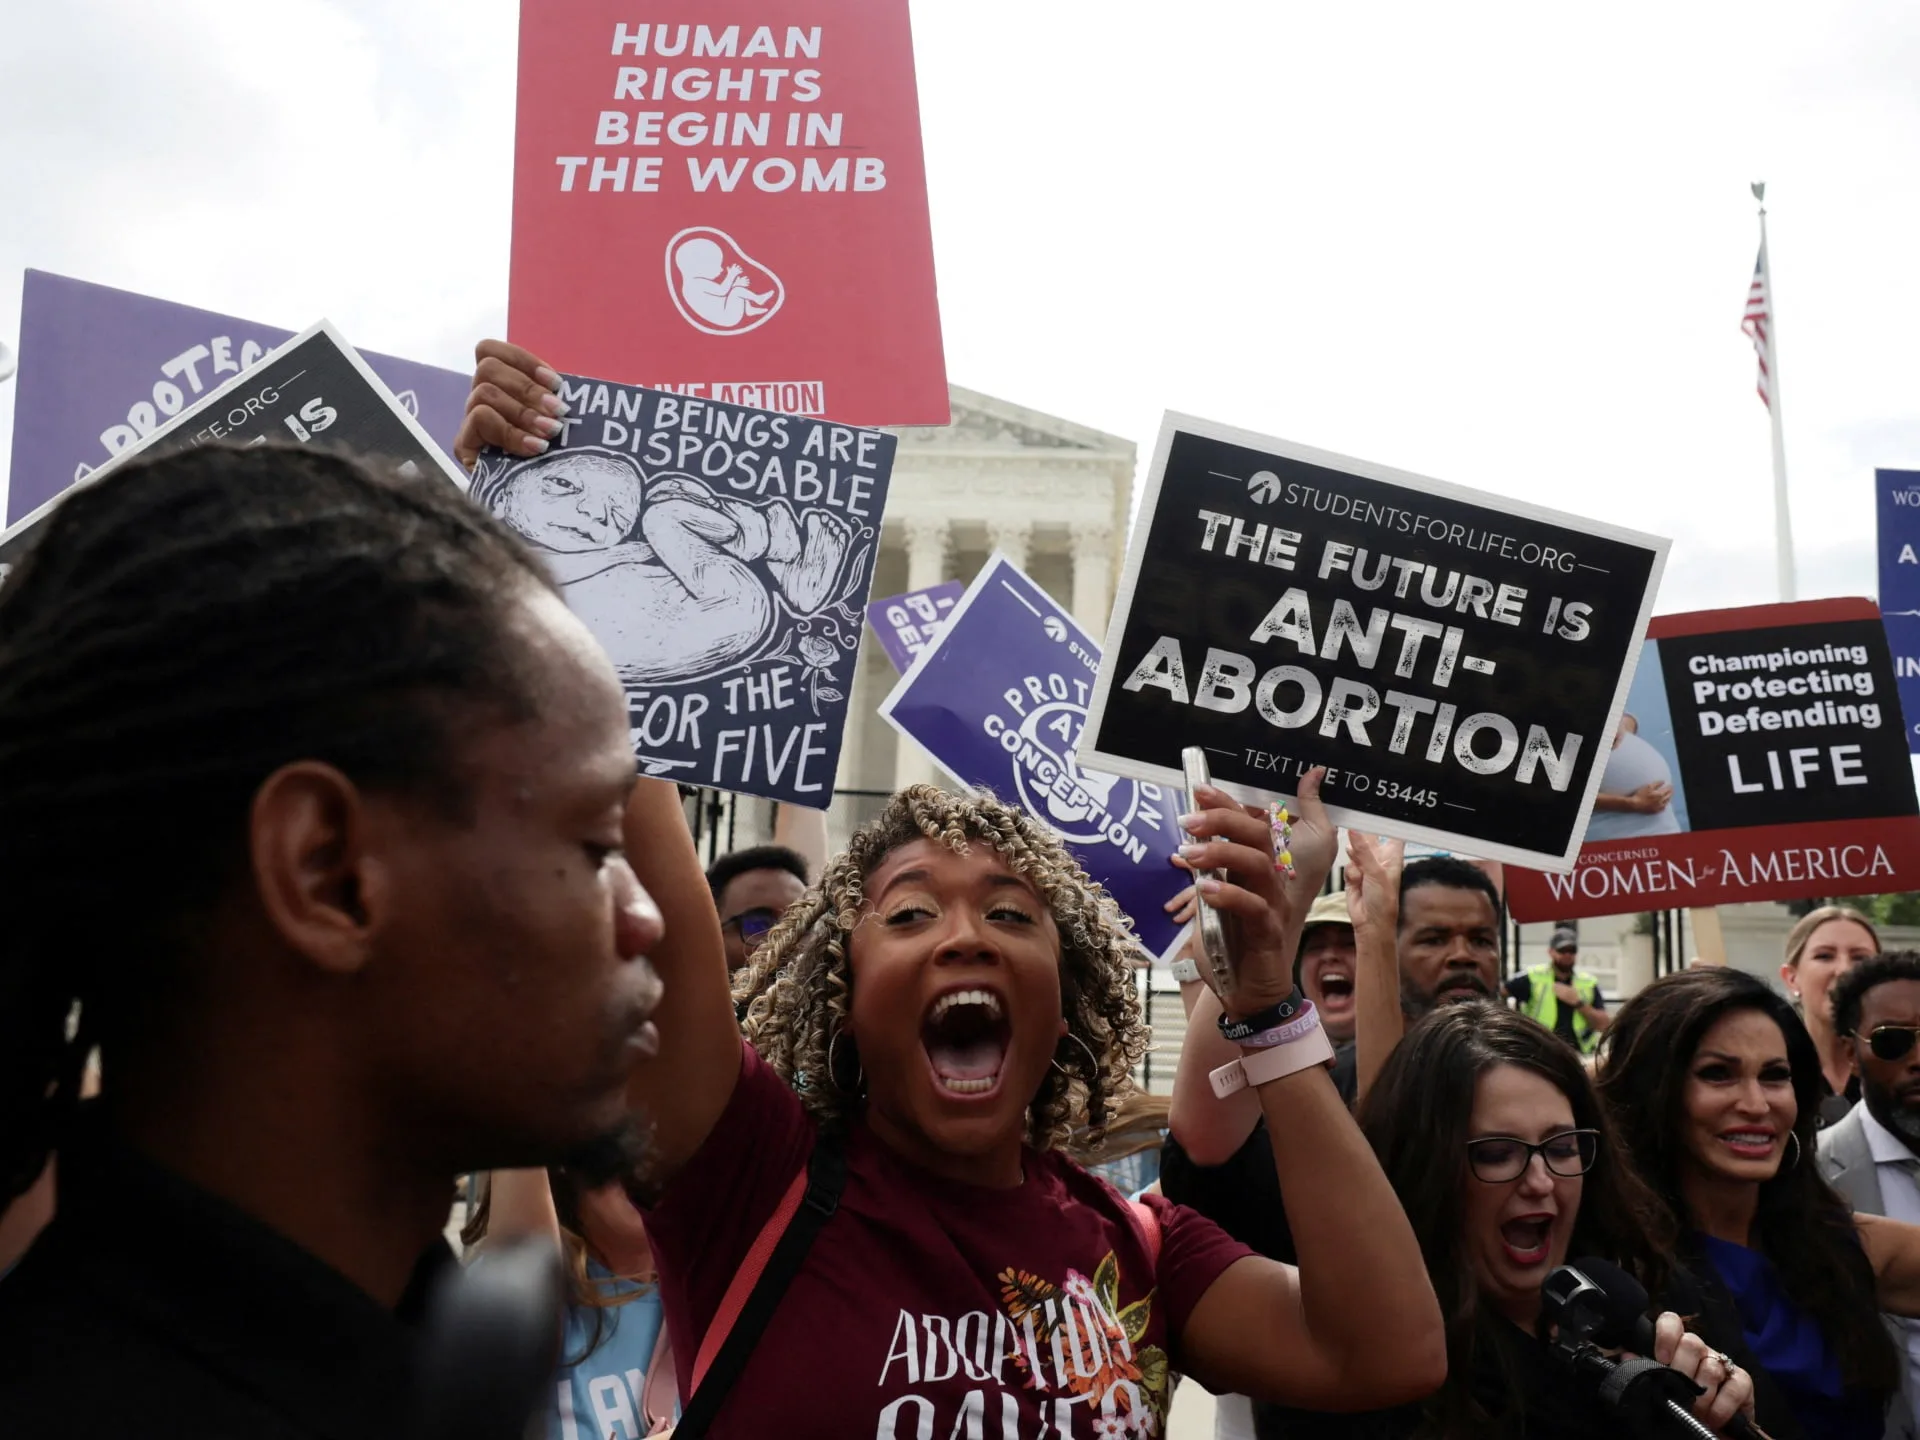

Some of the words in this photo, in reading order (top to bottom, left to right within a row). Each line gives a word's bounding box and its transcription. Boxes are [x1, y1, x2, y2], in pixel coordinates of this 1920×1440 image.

[611, 23, 822, 58] HUMAN
[613, 67, 822, 102] RIGHTS
[594, 110, 771, 147] BEGIN
[786, 113, 844, 147] IN
[555, 156, 662, 192] THE
[686, 157, 888, 193] WOMB
[100, 335, 275, 458] PROTEC
[283, 396, 338, 443] IS
[719, 382, 820, 414] ACTION
[556, 380, 642, 423] MAN
[654, 397, 789, 449] BEINGS
[802, 424, 881, 469] ARE
[602, 421, 875, 517] DISPOSABLE
[1284, 482, 1578, 574] STUDENTSFORLIFE.ORG
[1198, 509, 1303, 571] THE
[1317, 540, 1528, 627] FUTURE
[1542, 596, 1594, 642] IS
[1249, 586, 1497, 688] ANTI-
[1688, 643, 1868, 675] Championing
[722, 665, 795, 715] THE
[1693, 669, 1875, 704] Protecting
[1122, 635, 1584, 793] ABORTION
[1698, 700, 1882, 736] Defending
[712, 722, 827, 792] FIVE
[1244, 748, 1292, 774] TEXT
[1344, 771, 1370, 792] TO
[1375, 779, 1439, 808] 53445
[1727, 744, 1868, 793] LIFE
[983, 713, 1148, 864] CONCEPTION
[1544, 857, 1697, 901] WOMEN
[1719, 844, 1895, 887] AMERICA
[1579, 847, 1659, 866] CONCERNED
